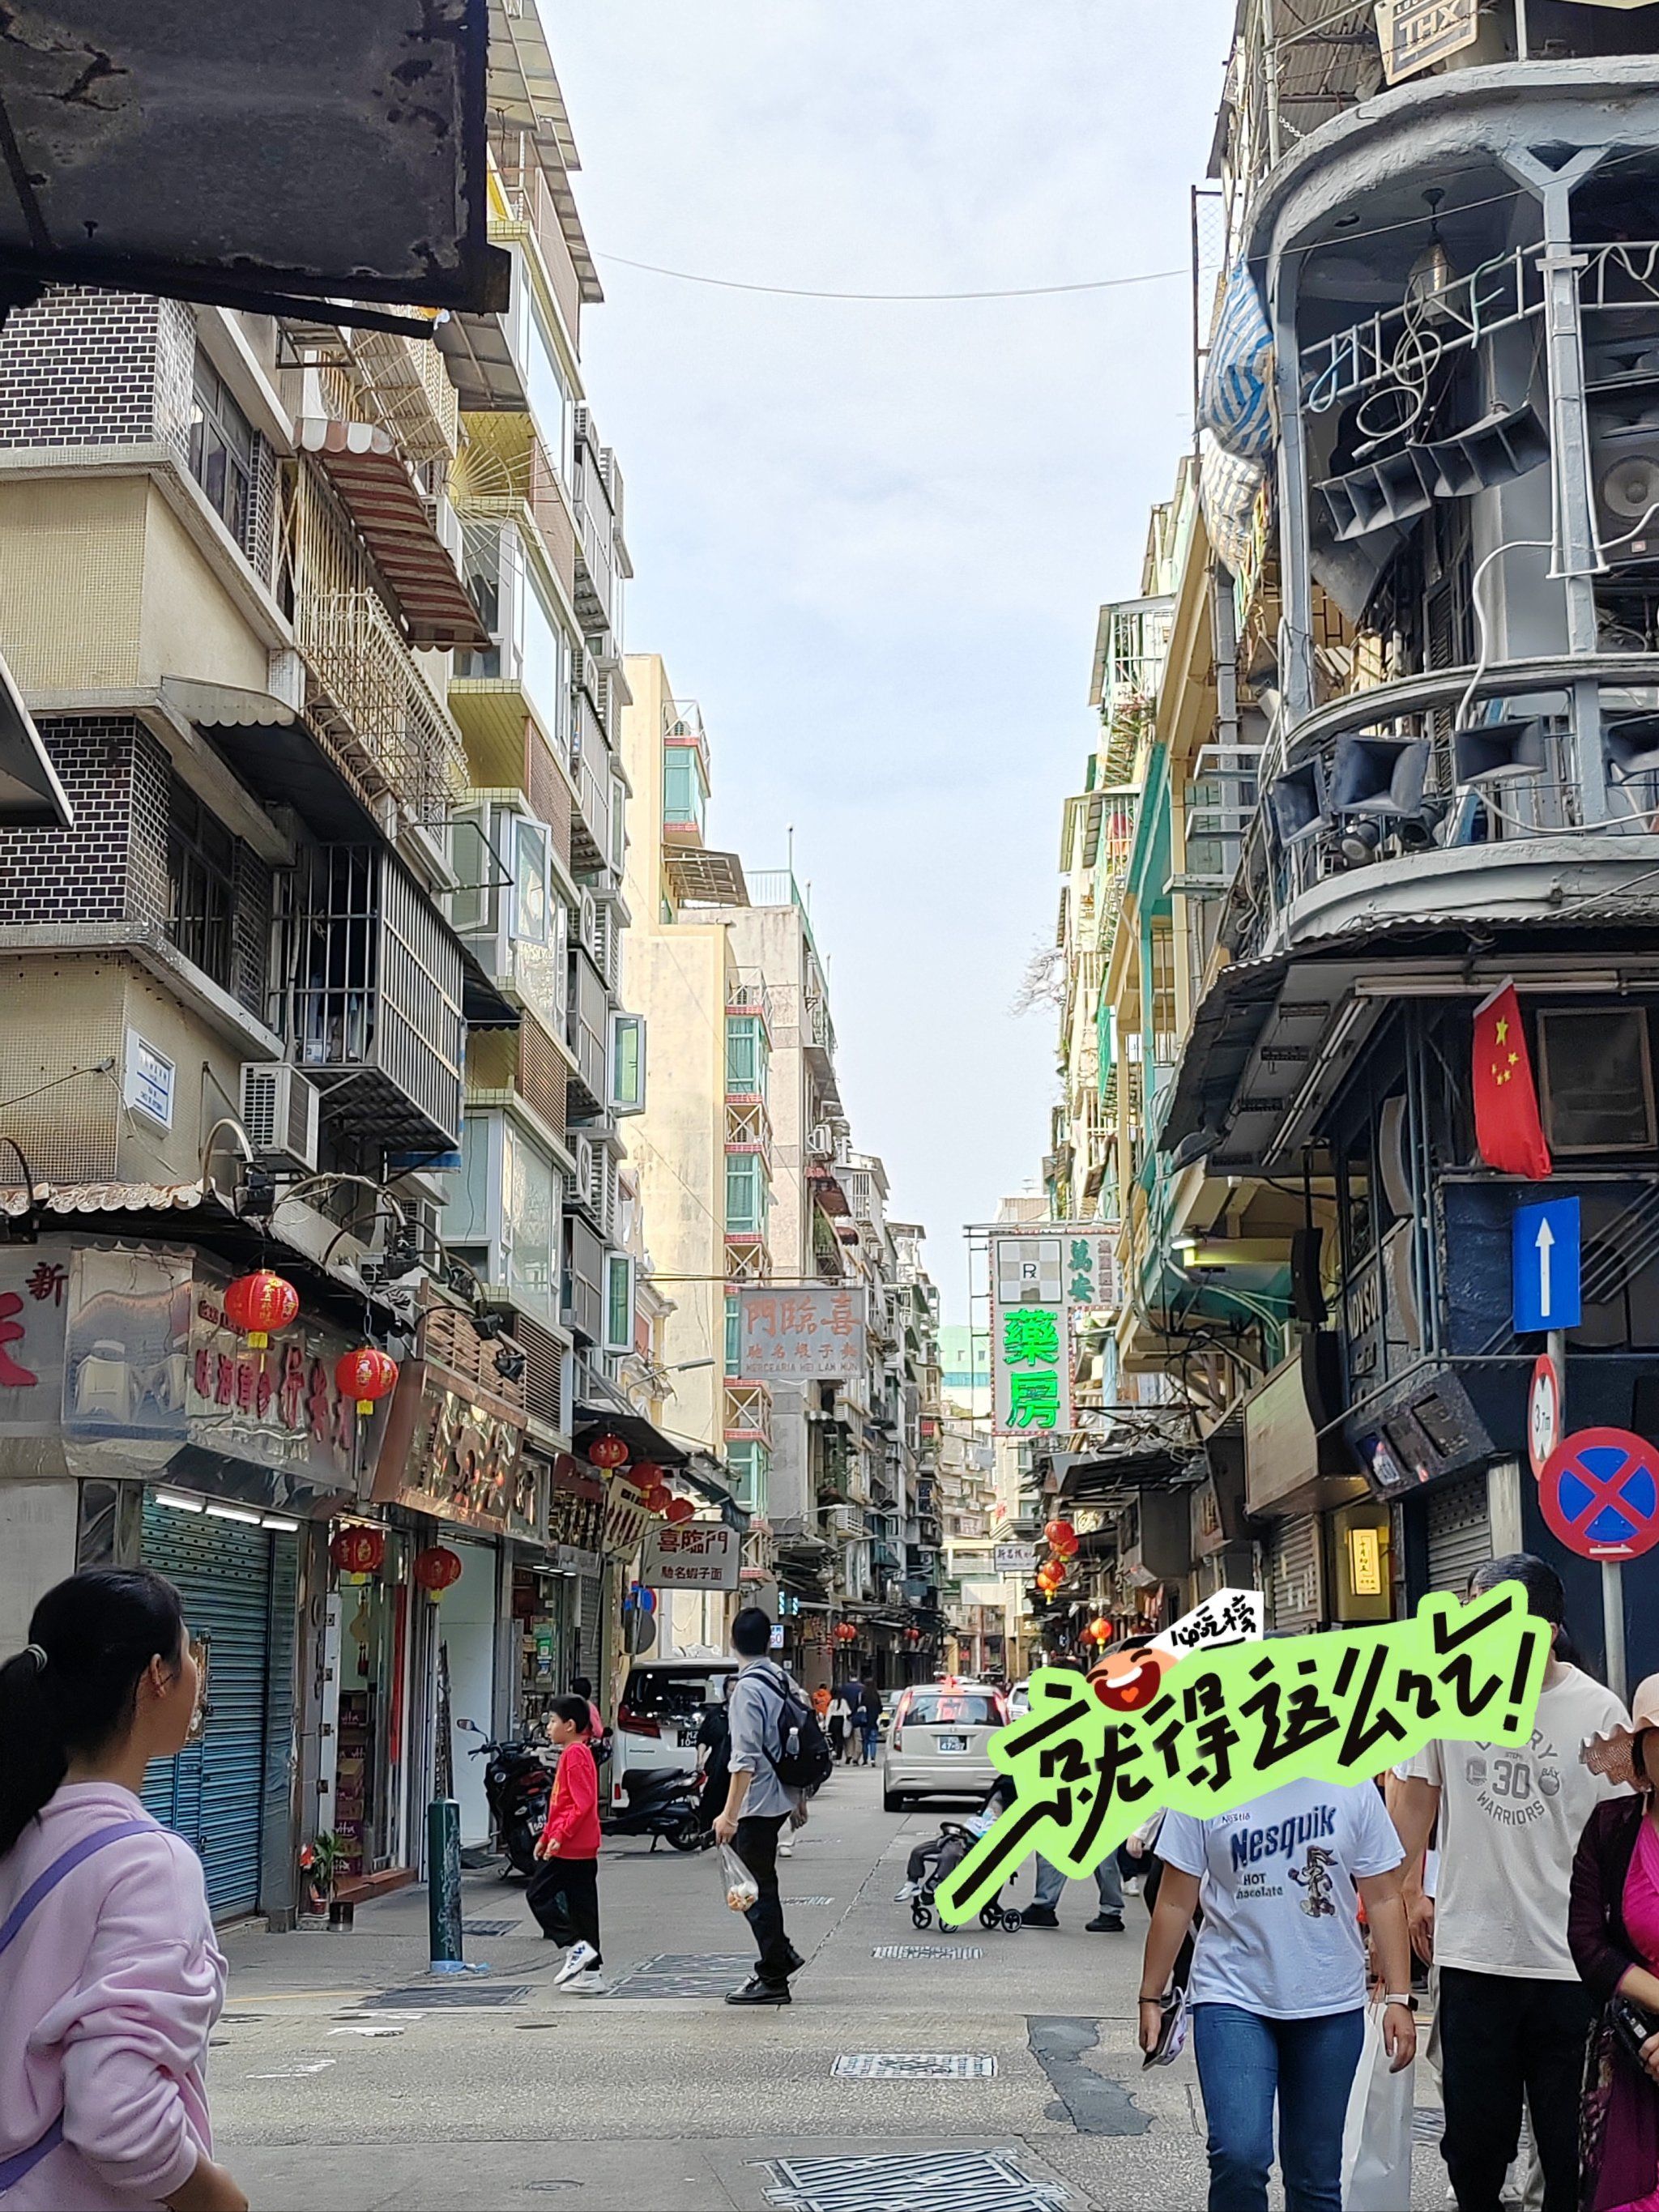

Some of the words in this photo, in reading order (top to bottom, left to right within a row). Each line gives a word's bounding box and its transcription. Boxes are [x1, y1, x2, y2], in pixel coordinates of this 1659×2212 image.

[1399, 2, 1461, 49] THX
[1002, 1308, 1060, 1430] 藥房
[657, 1528, 729, 1555] 喜臨門
[1492, 1759, 1530, 1800] 30
[1477, 1790, 1545, 1826] WARRIORS
[1230, 1805, 1337, 1873] Nesquik
[1243, 1873, 1267, 1886] HOT
